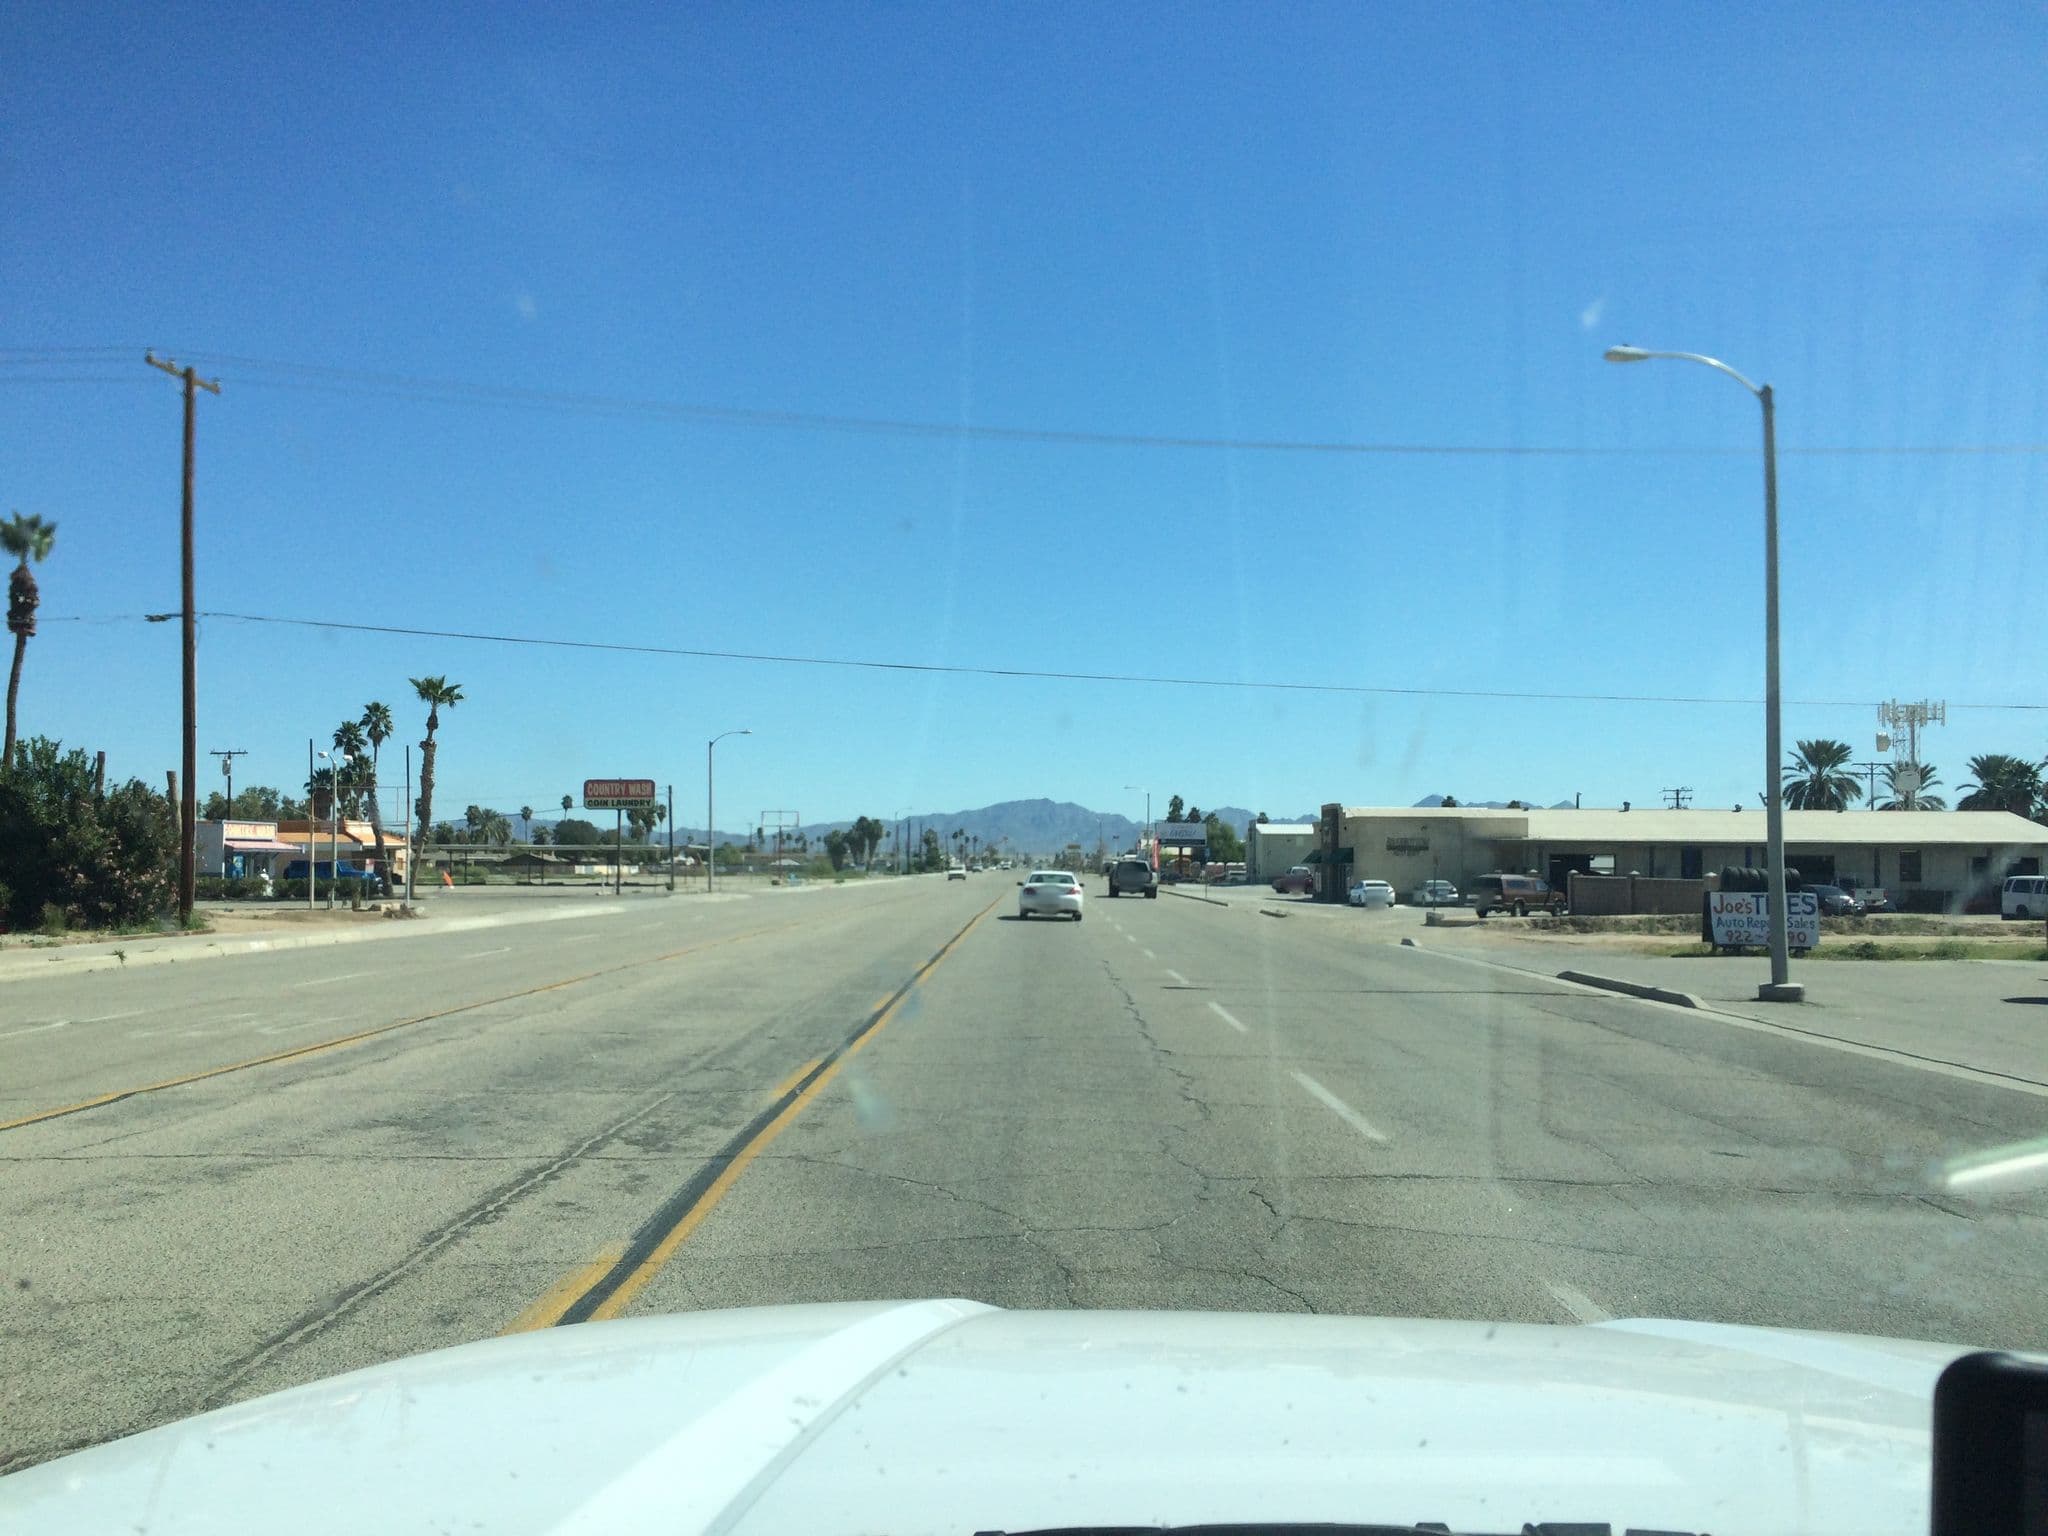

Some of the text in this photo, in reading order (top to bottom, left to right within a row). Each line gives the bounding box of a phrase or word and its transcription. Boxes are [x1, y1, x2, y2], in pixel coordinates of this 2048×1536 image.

[588, 783, 652, 796] COUNTRY WASH
[587, 799, 651, 807] COIN LAUNDRY
[1713, 894, 1817, 915] Joe's TIES
[1716, 916, 1744, 928] Auto
[1787, 916, 1815, 929] Sales
